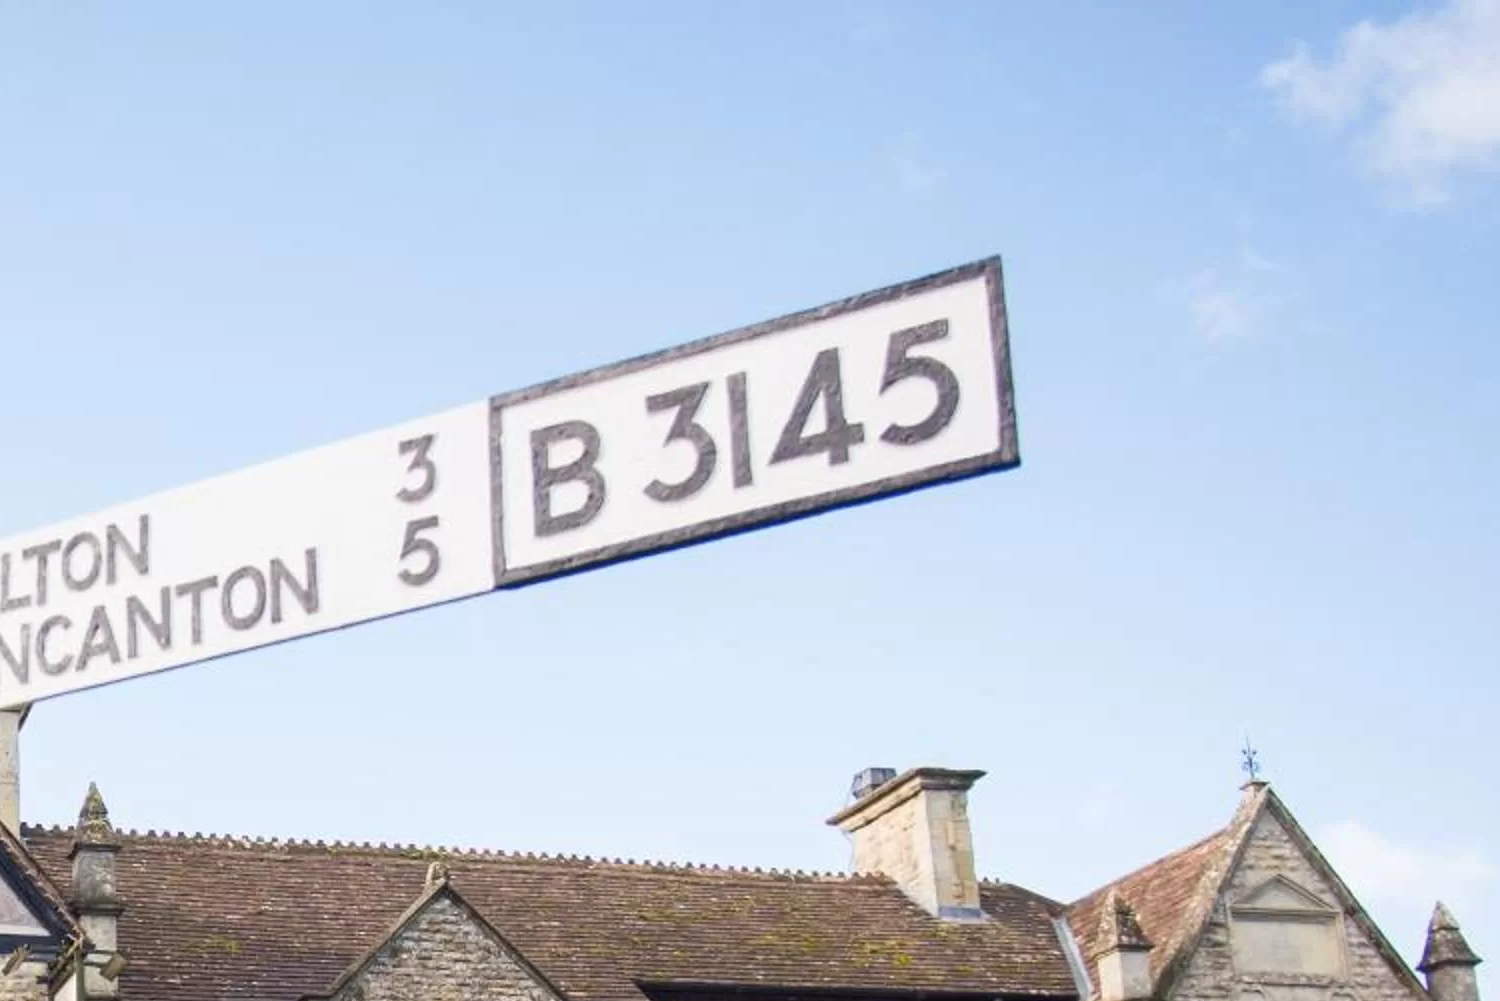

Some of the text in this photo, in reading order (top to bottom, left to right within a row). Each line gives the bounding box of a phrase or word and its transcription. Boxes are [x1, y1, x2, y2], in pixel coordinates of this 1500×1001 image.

[528, 317, 961, 538] B 3145
[395, 432, 438, 503] 3
[396, 514, 441, 588] 5
